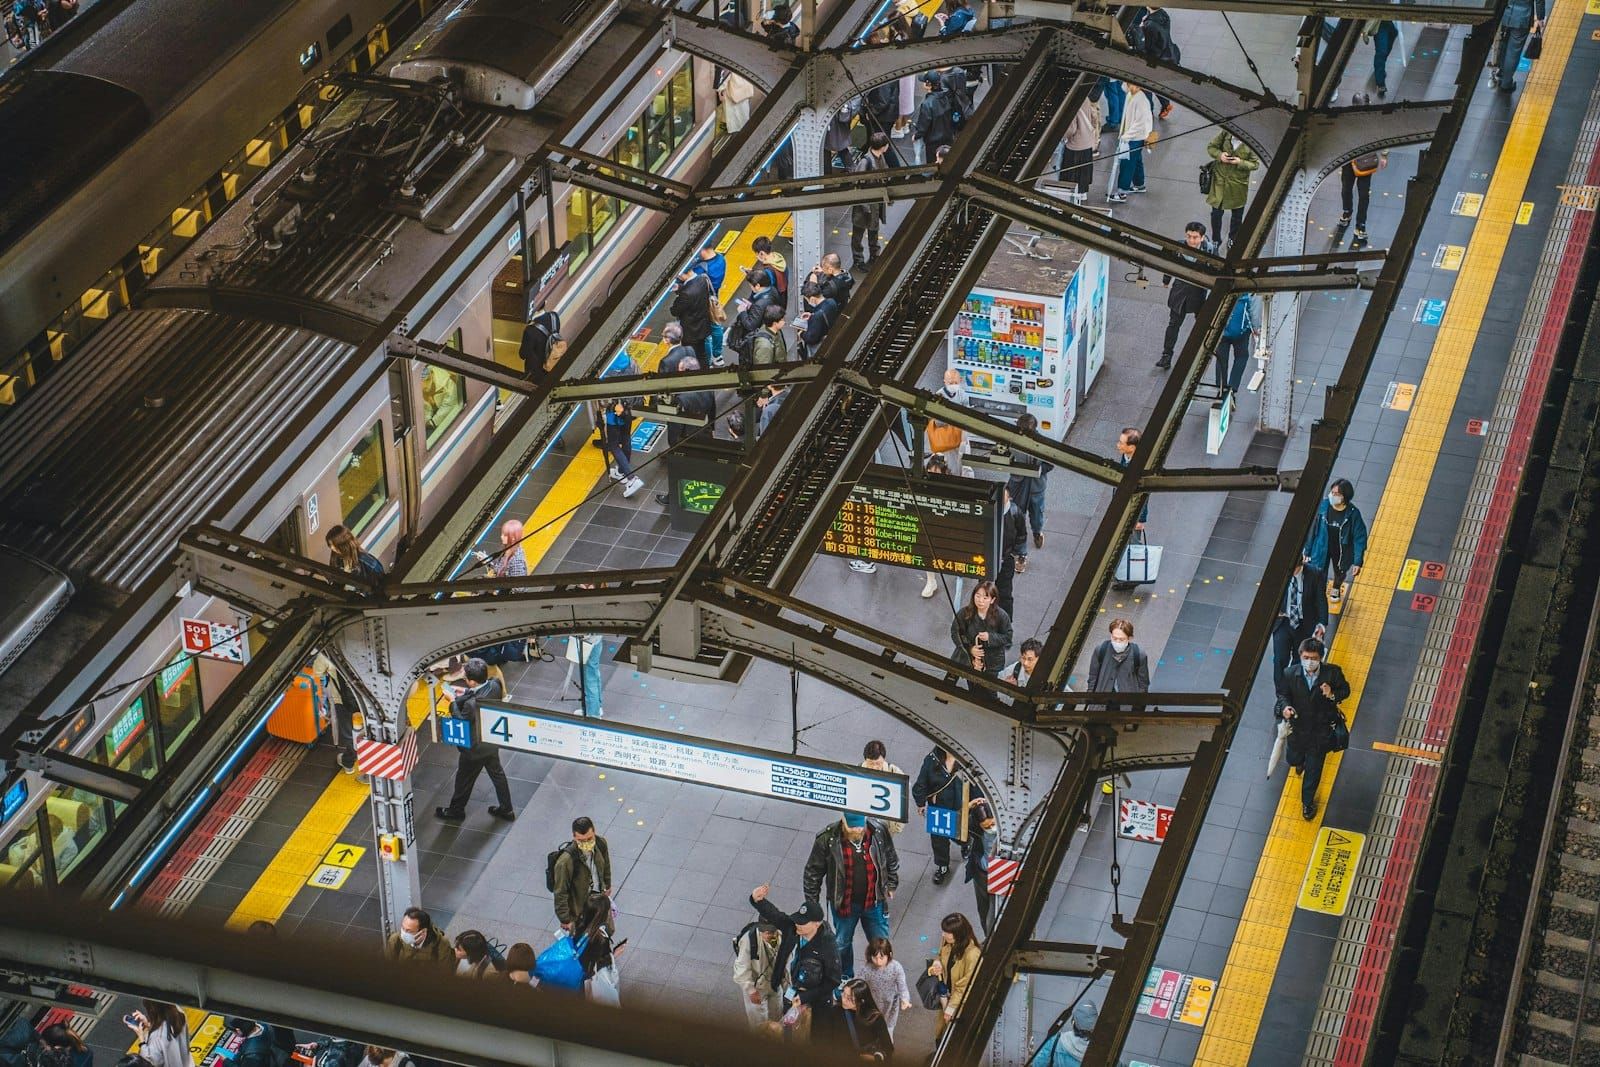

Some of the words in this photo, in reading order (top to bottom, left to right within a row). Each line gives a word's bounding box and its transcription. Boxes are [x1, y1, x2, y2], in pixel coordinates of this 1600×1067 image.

[974, 504, 983, 516] 3
[876, 538, 912, 553] Tottori
[186, 624, 207, 635] SOS
[446, 720, 464, 738] 11
[490, 716, 513, 742] 4
[783, 766, 810, 777] こうのとり
[869, 783, 891, 812] 3
[931, 809, 951, 829] 11
[1131, 812, 1155, 821] ボタン
[1319, 847, 1336, 868] Watch
[1315, 867, 1328, 883] your
[1310, 883, 1323, 898] step
